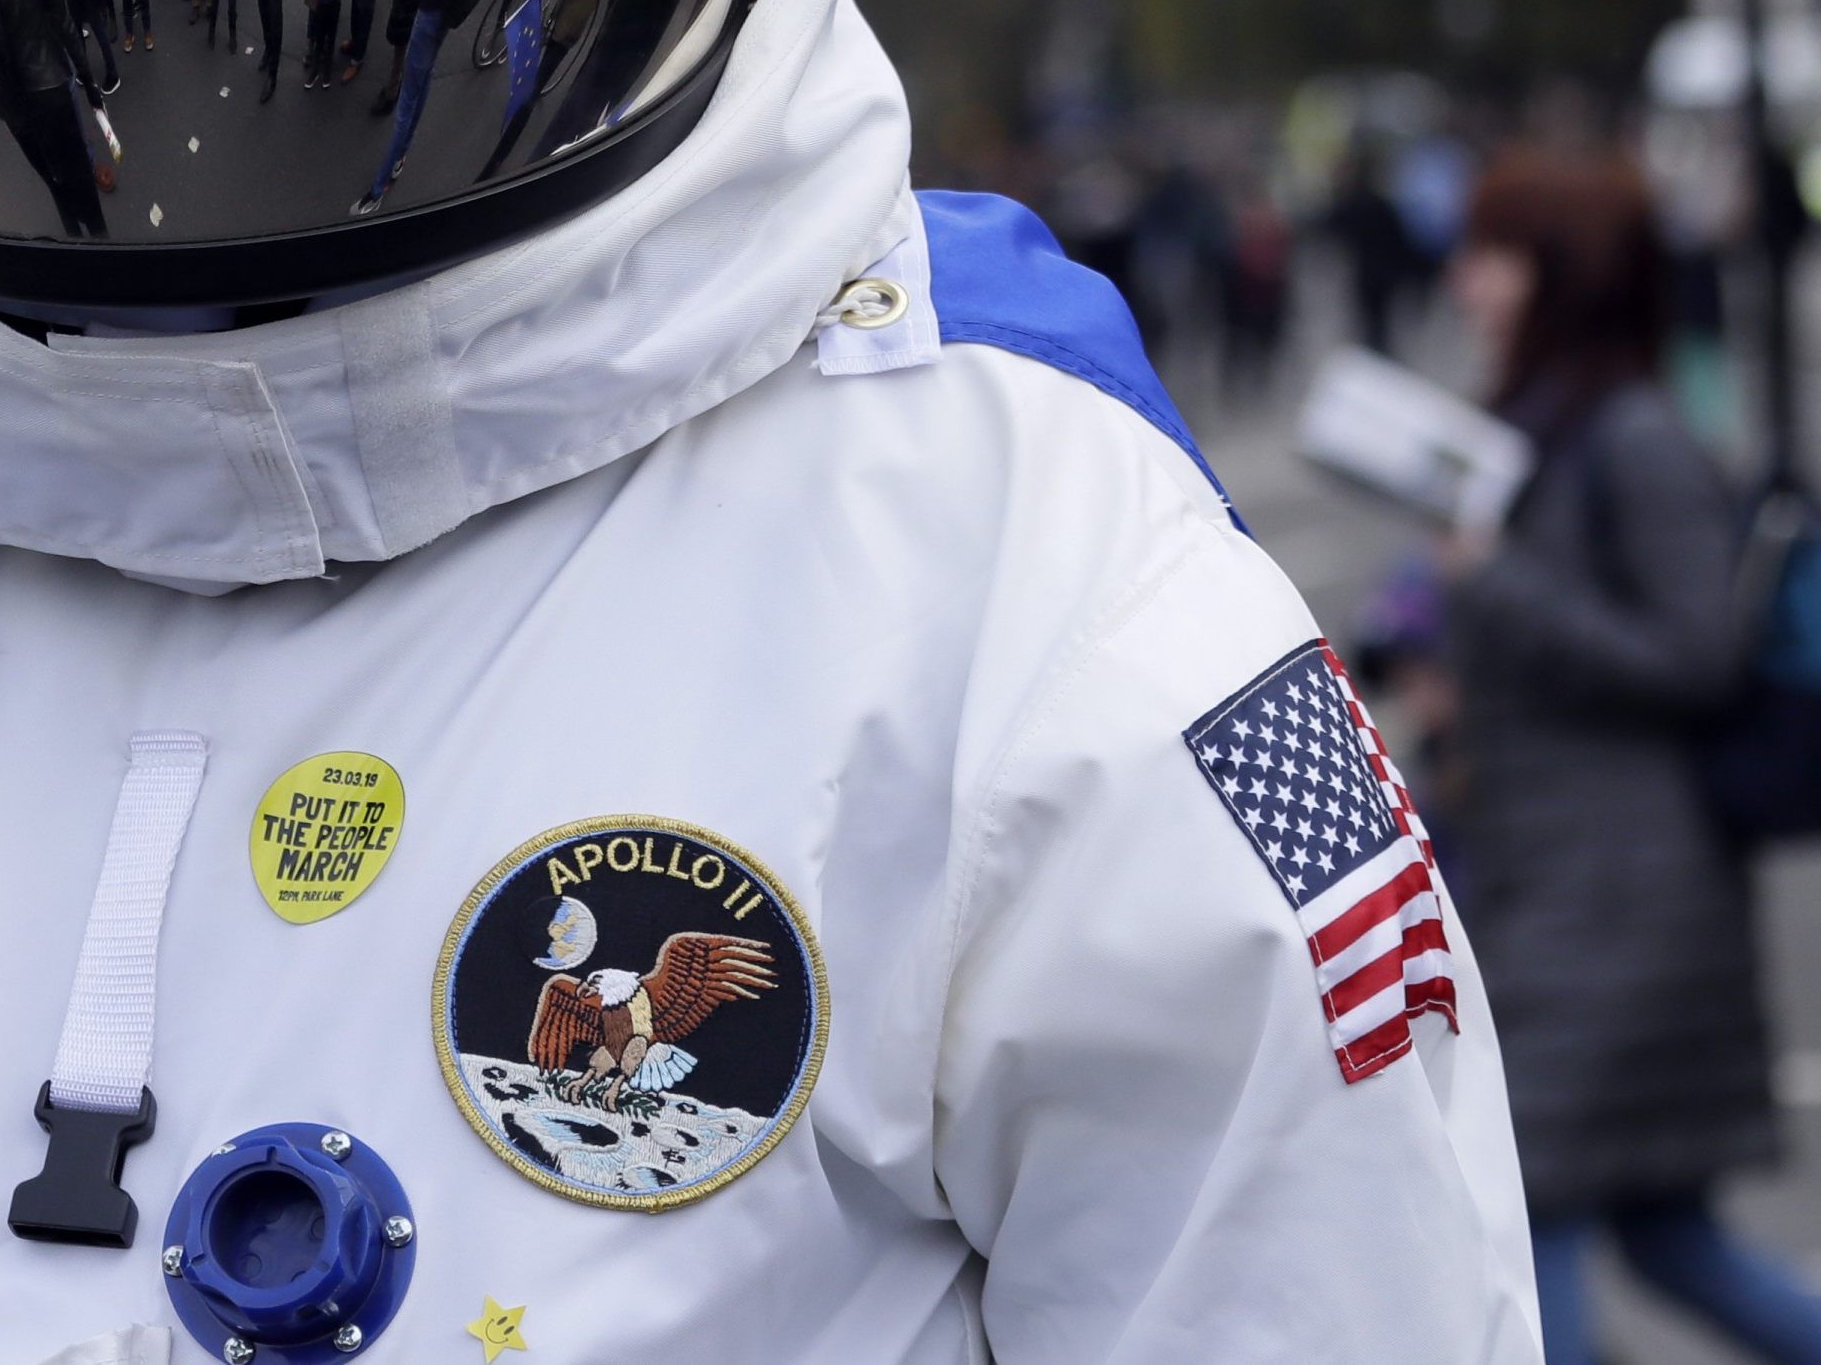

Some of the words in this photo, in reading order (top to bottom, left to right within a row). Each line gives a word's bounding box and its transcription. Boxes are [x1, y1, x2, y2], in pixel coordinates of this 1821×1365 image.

[322, 768, 378, 787] 23.03.19
[290, 792, 335, 822] PUT
[338, 801, 360, 823] IT
[363, 802, 385, 824] TO
[263, 814, 311, 847] THE
[315, 824, 394, 850] PEOPLE
[276, 848, 364, 882] MARCH
[547, 837, 726, 895] APOLLO
[722, 879, 764, 921] 11
[301, 890, 322, 901] PARK
[322, 890, 344, 901] LANE
